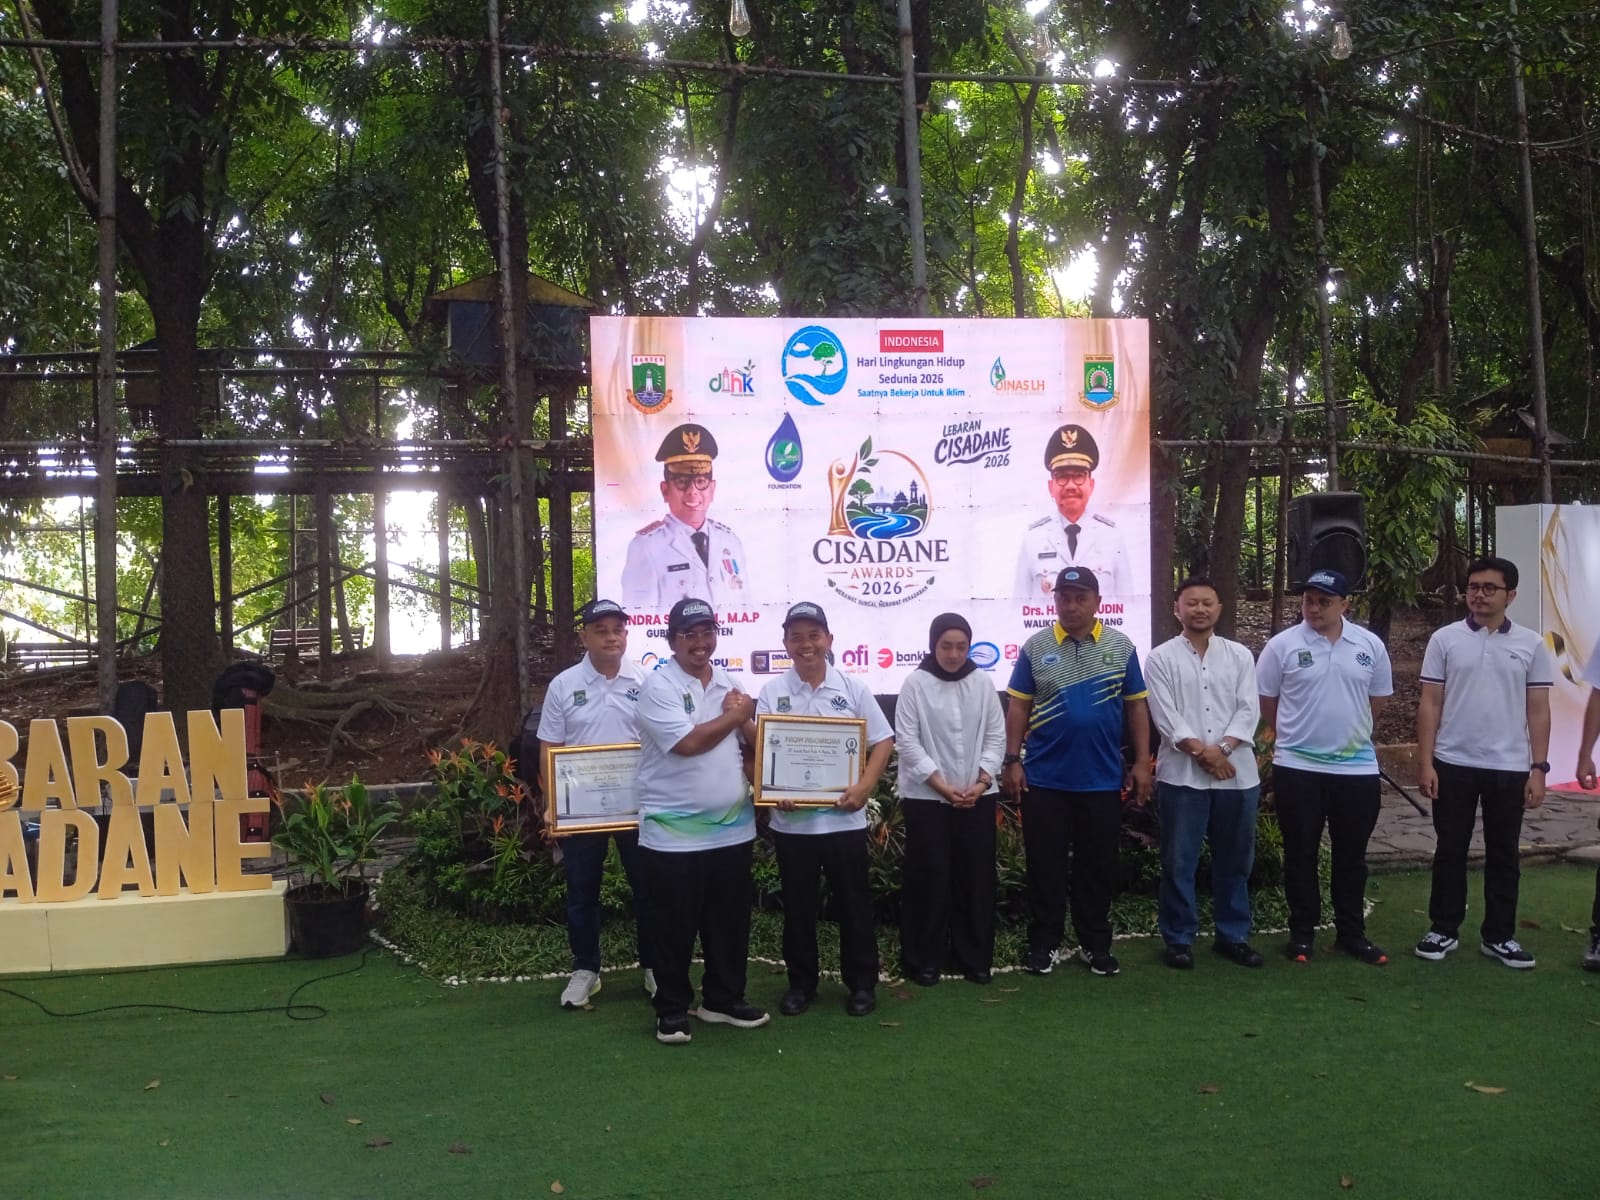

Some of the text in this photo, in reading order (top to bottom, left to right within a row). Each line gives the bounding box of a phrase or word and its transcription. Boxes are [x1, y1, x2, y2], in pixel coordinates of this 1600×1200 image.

[884, 336, 939, 347] INDONESIA
[856, 357, 965, 369] Hari Lingkungan Hidup
[878, 373, 944, 384] Sedunia 2026
[1031, 380, 1045, 391] LH
[857, 388, 966, 399] Saatnya Bekerja Untuk Iklim
[942, 419, 981, 437] LEBARAN
[934, 428, 1011, 464] CISADANE
[984, 453, 1010, 468] 2026
[812, 538, 950, 565] CISADANE
[851, 567, 914, 579] AWARDS
[862, 581, 903, 595] 2026
[1022, 604, 1124, 616] Drs. H. UDIN
[727, 612, 760, 623] M.A.P
[1024, 617, 1123, 629] WALIKO RANG
[716, 627, 733, 636] TEN
[842, 644, 868, 666] ofi
